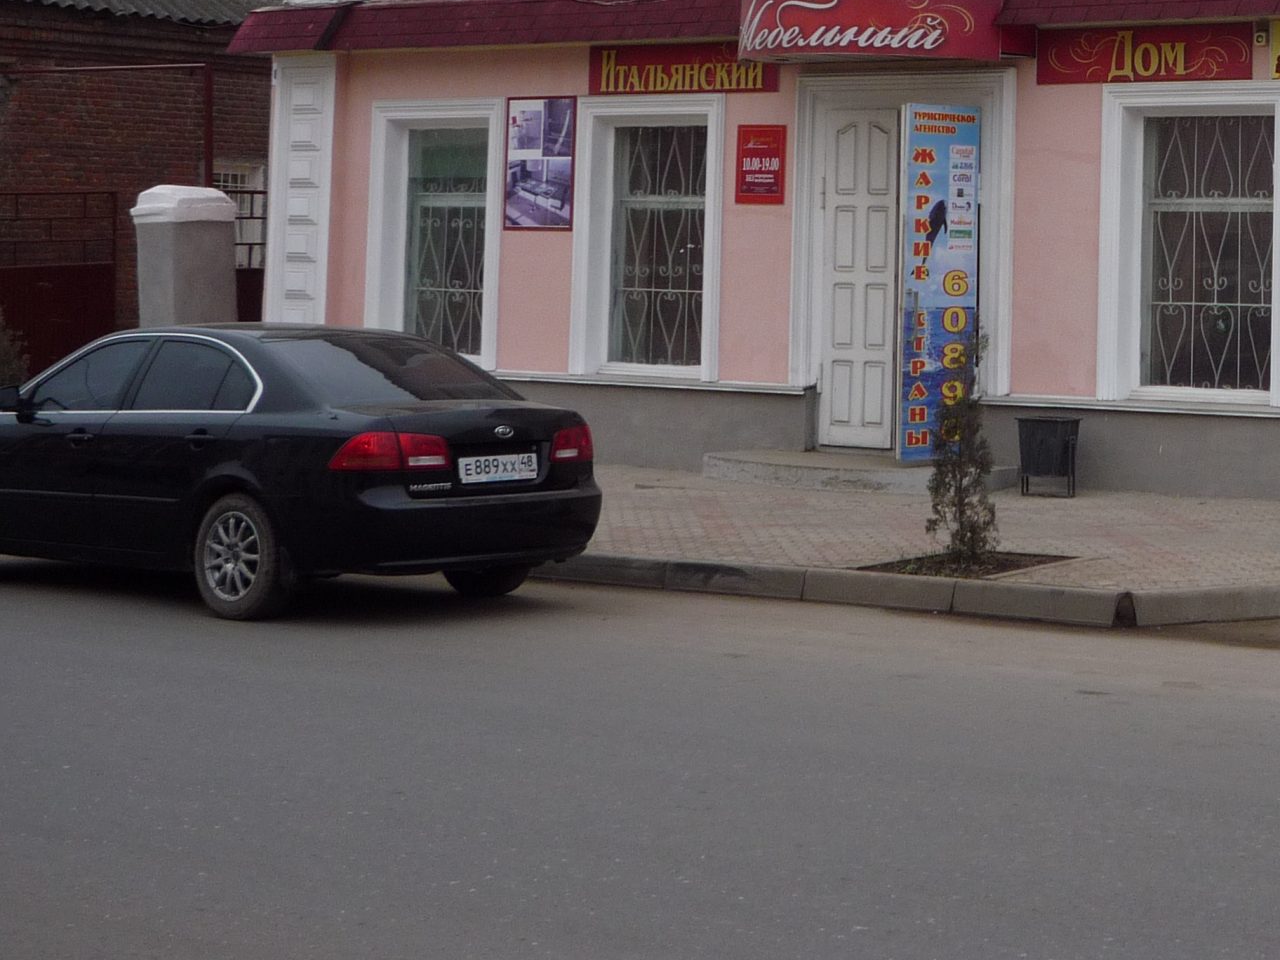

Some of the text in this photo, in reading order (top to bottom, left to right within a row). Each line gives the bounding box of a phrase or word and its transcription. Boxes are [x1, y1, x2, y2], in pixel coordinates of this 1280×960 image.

[913, 112, 976, 123] ТУРИСТИЧЕСКОЕ
[914, 124, 957, 134] АГЕНТСТВО
[743, 157, 779, 171] 10.00-19.00
[913, 148, 935, 280] ЖАРКИЕ
